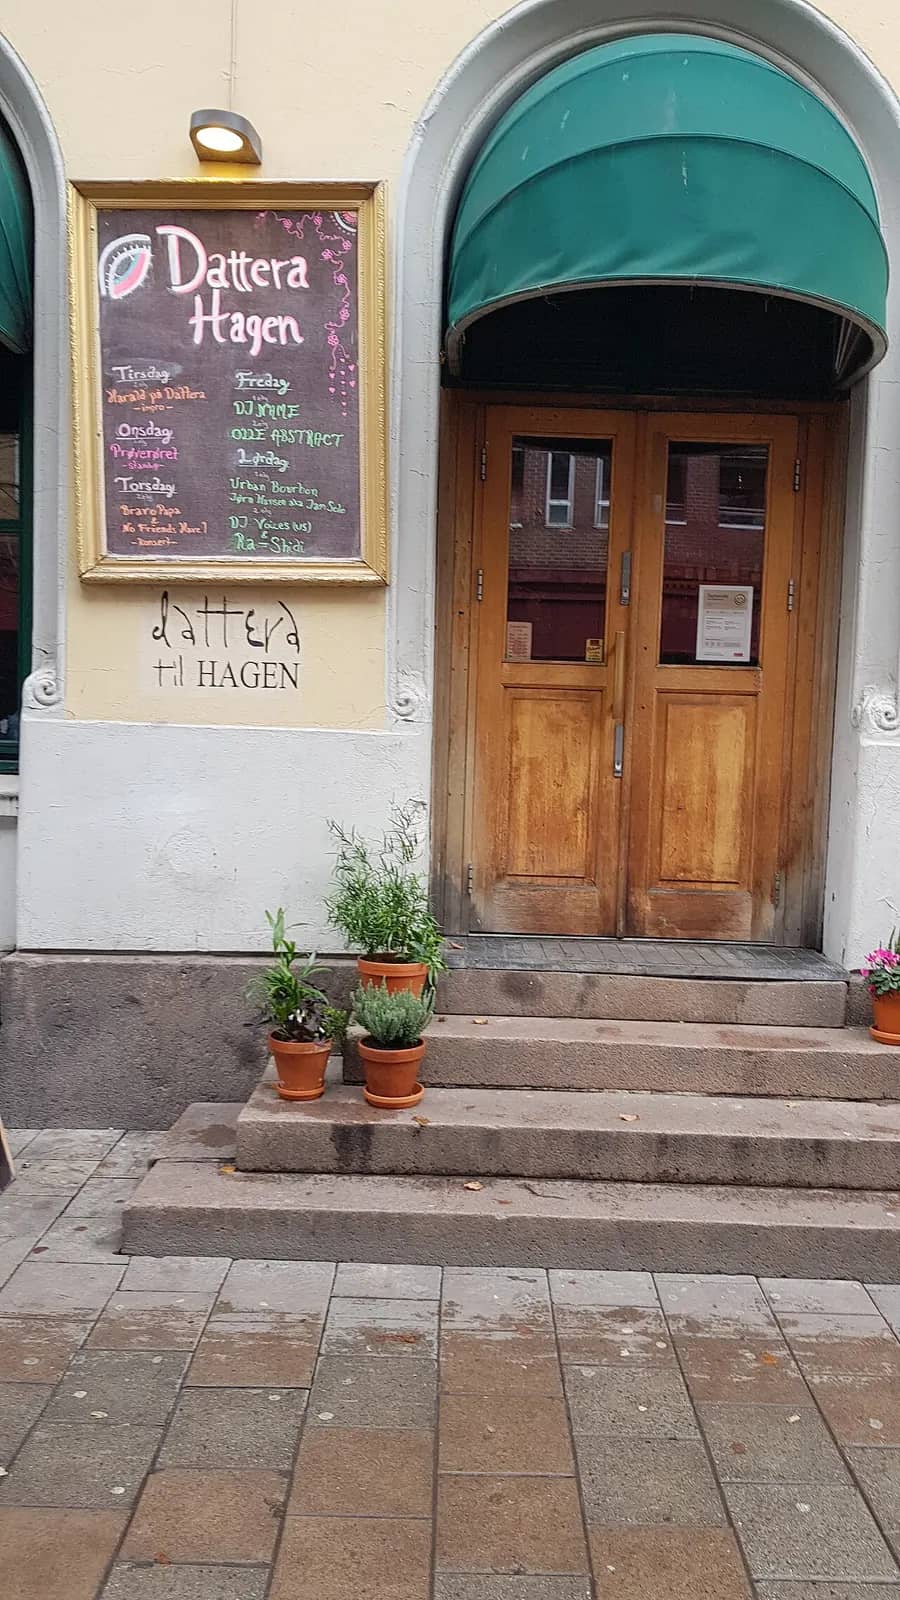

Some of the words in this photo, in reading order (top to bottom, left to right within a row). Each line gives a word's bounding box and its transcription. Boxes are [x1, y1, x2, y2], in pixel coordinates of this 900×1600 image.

[155, 224, 310, 293] Dattera
[188, 288, 304, 357] Hagen
[111, 365, 173, 384] Tirsdag
[235, 370, 292, 395] Fredag
[233, 400, 254, 416] DJ
[116, 420, 175, 445] Onsdag
[270, 429, 345, 448] ABSTRACT
[236, 448, 291, 473] Lørdag
[113, 476, 178, 498] Torsdag
[229, 477, 267, 491] Urban
[271, 480, 319, 497] Bourbon
[228, 516, 248, 529] DJ
[253, 518, 291, 530] Voices
[152, 590, 300, 654] dattera
[196, 660, 301, 689] HAGEN
